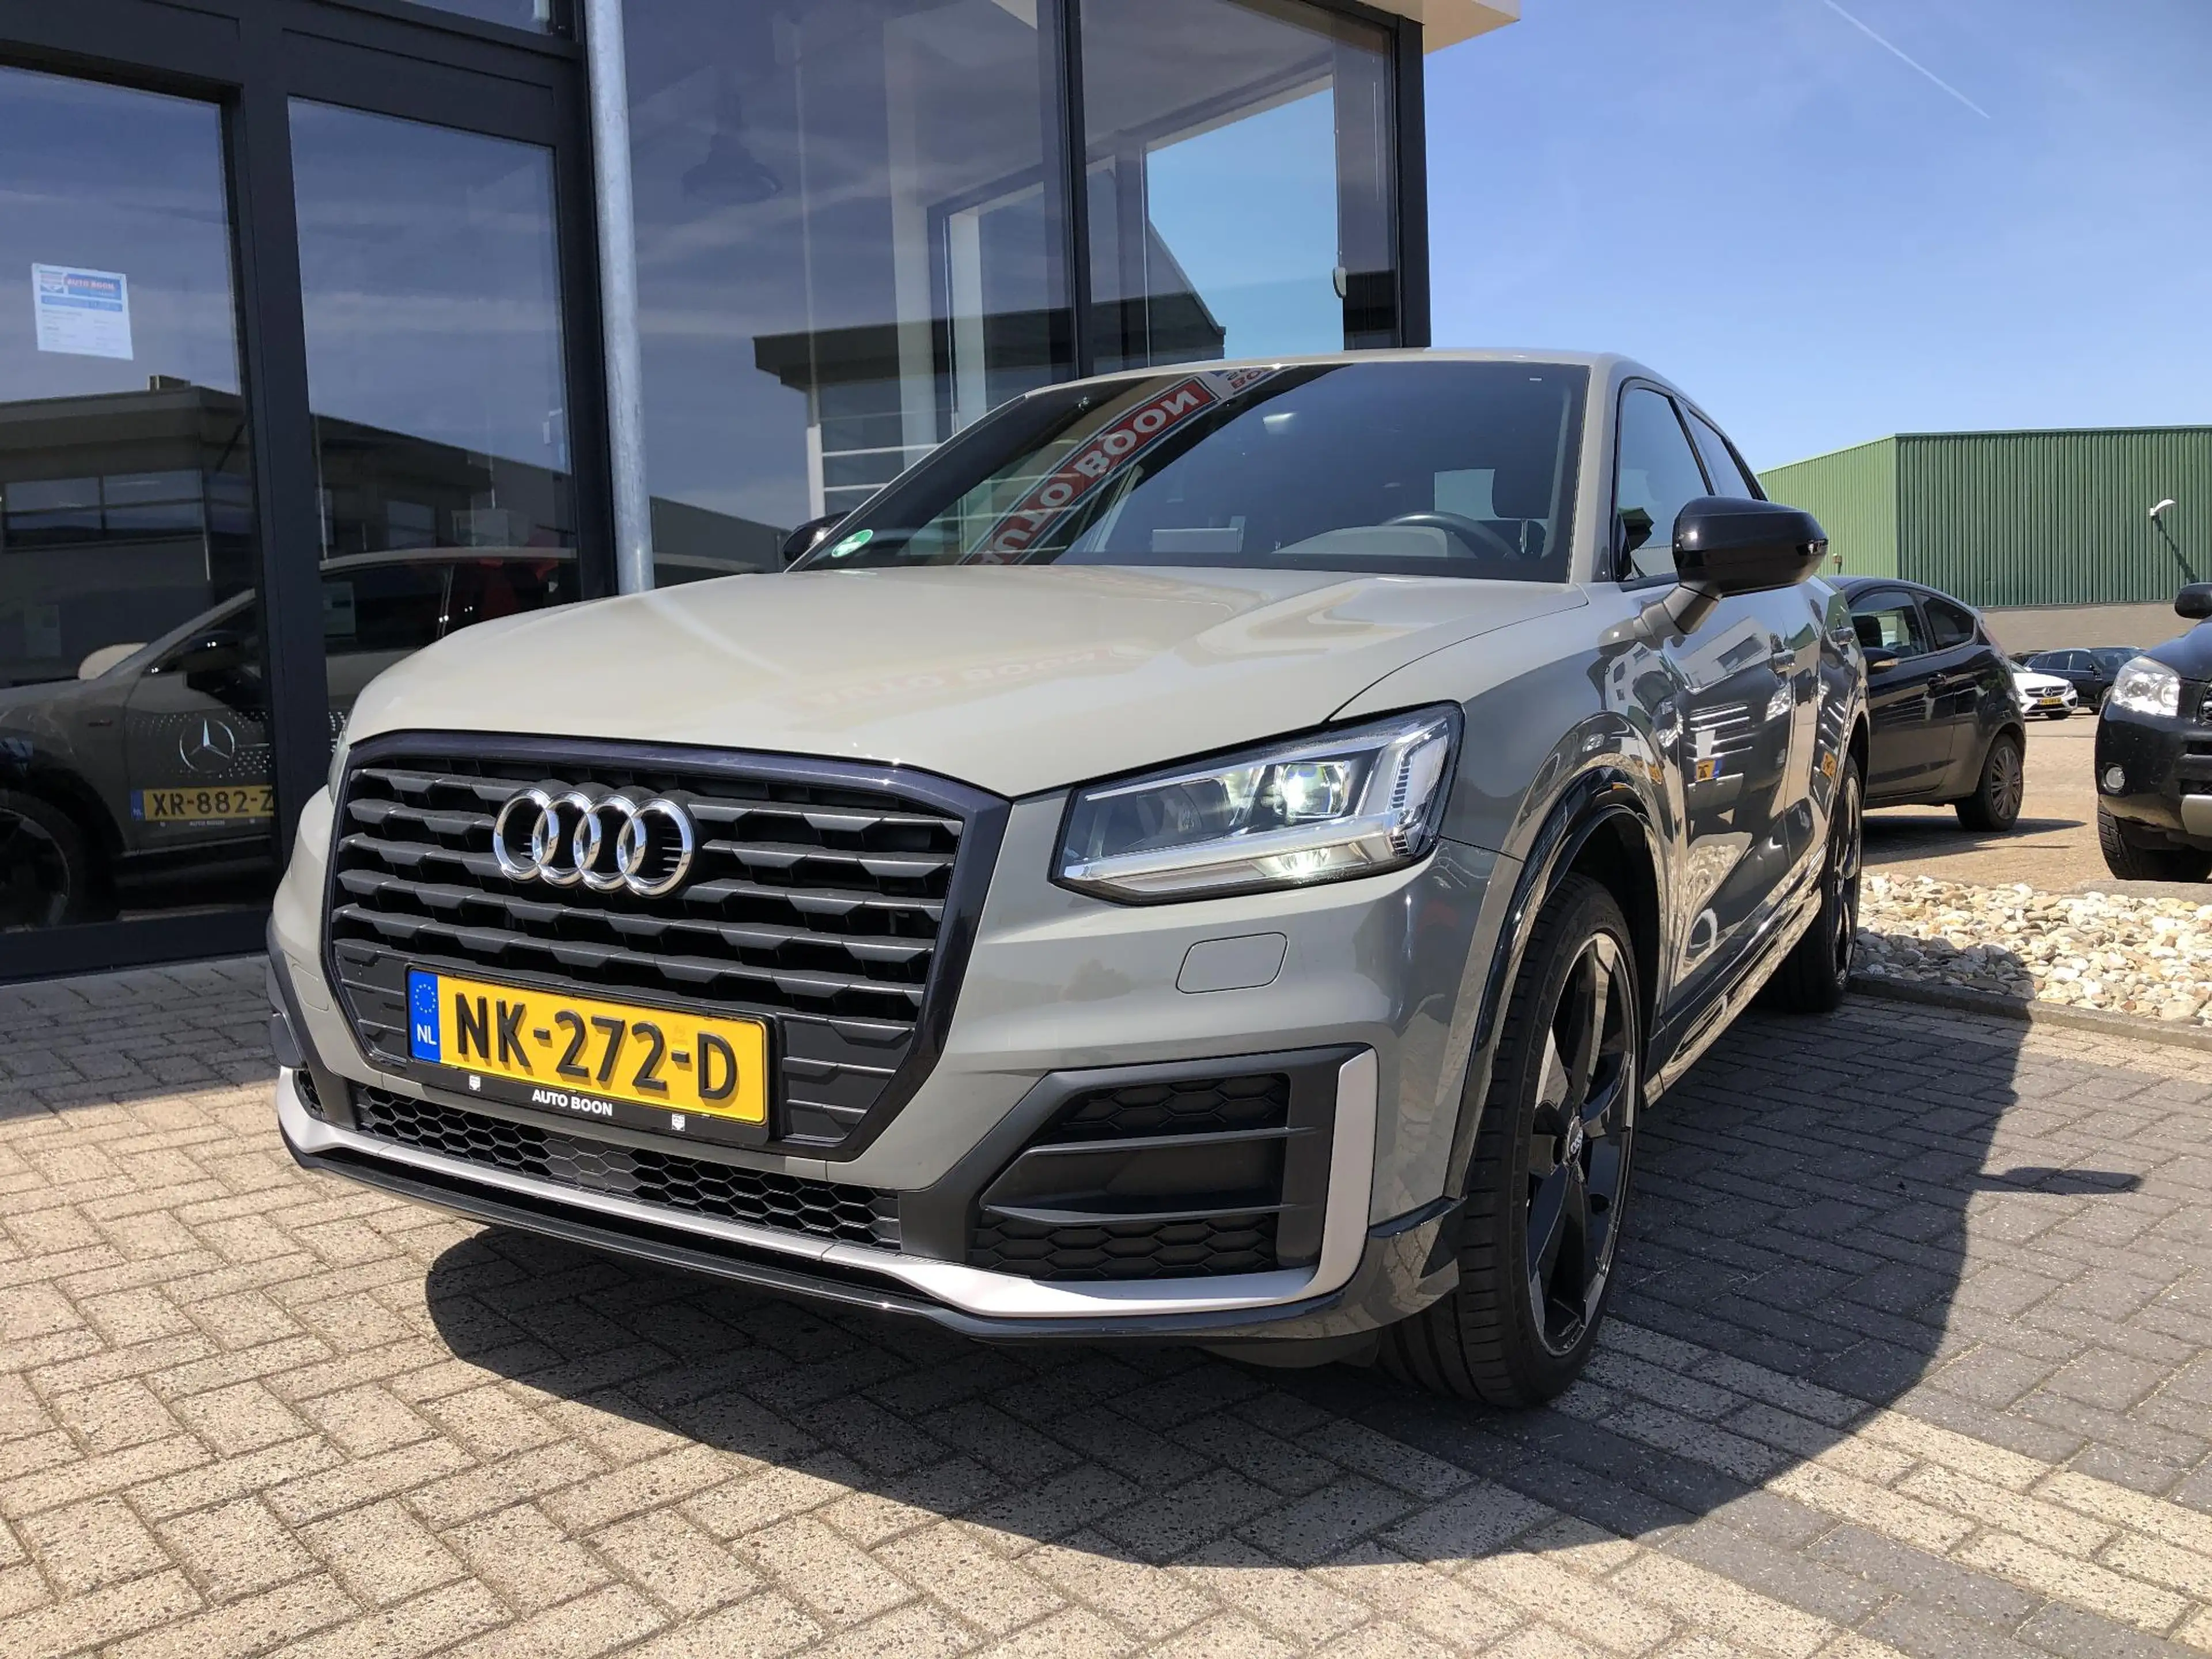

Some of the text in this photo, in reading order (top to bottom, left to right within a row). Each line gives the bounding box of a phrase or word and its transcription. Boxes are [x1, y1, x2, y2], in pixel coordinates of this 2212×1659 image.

[152, 790, 274, 817] XR-882-Z
[416, 1023, 437, 1046] NL
[455, 993, 738, 1100] NK-272-D
[532, 1089, 613, 1116] AUTO BOON
